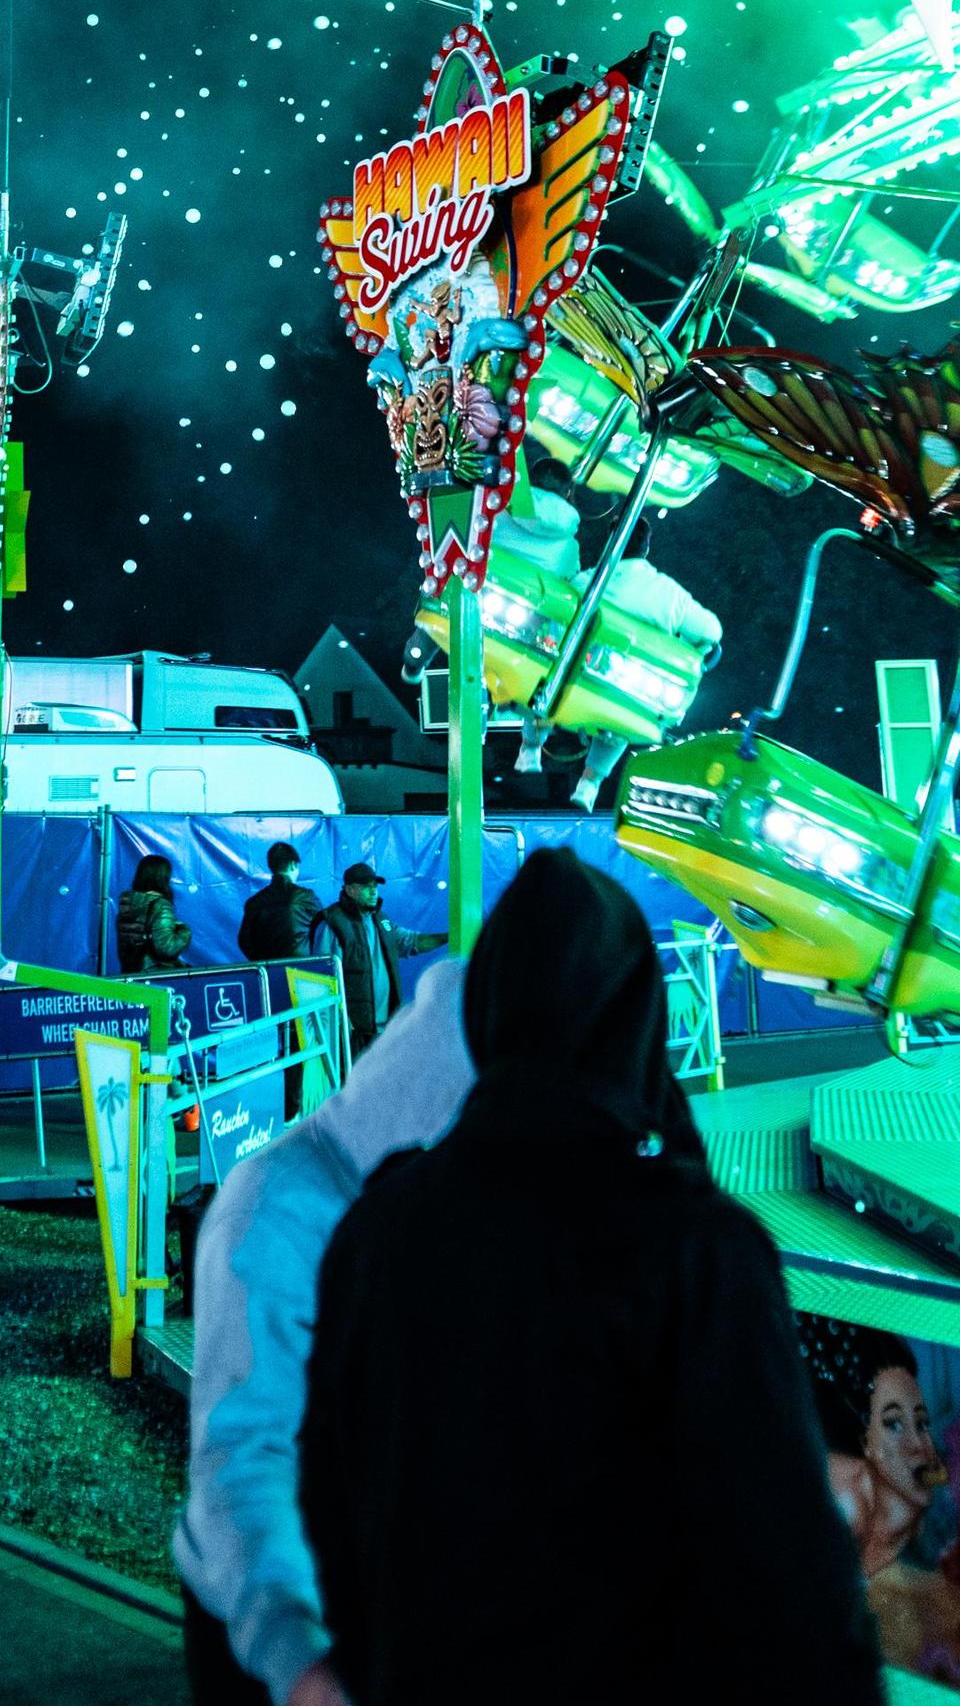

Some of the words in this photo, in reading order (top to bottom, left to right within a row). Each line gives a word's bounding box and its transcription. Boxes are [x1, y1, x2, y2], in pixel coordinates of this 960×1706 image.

[354, 92, 526, 241] HAWAII
[359, 187, 490, 309] Swing
[41, 1019, 119, 1043] WHEECHAIR
[123, 1017, 149, 1038] RAM
[211, 1102, 249, 1141] Rauchen
[235, 1116, 274, 1160] verboten!
